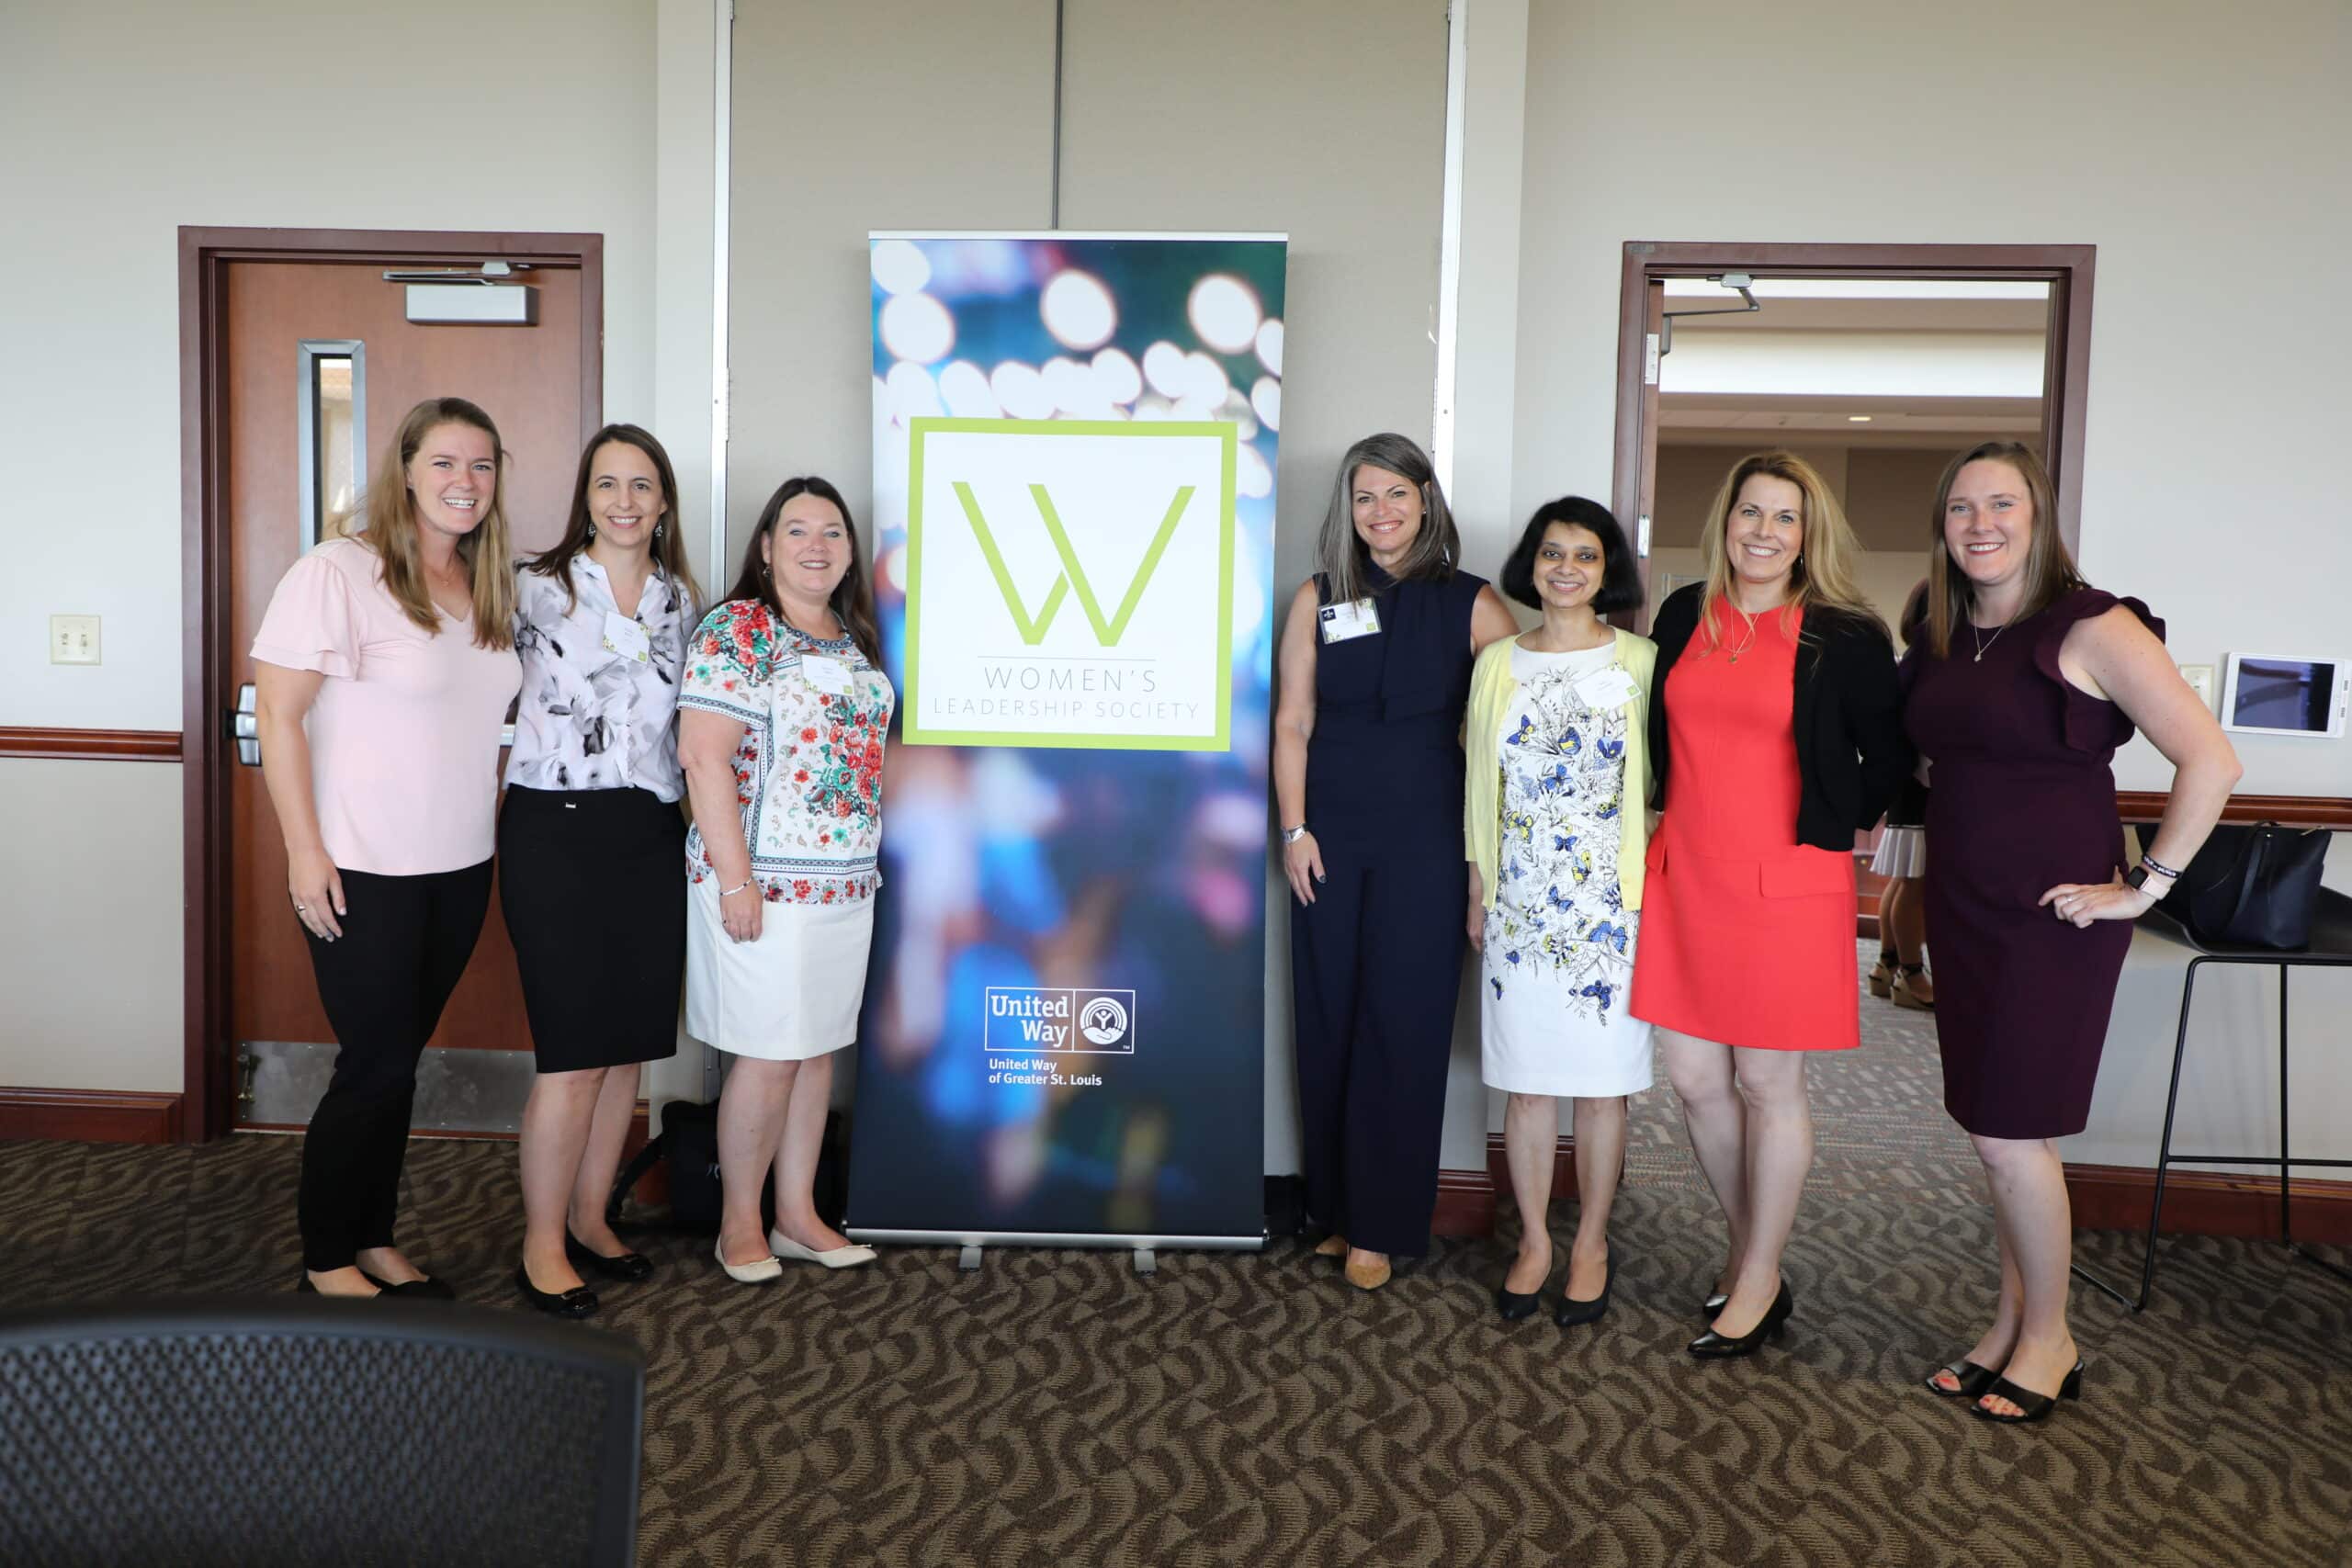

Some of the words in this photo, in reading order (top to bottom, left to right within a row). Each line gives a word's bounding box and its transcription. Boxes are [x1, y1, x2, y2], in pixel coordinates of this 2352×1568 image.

[951, 481, 1196, 647] W
[984, 667, 1156, 692] WOMEN'S
[933, 698, 1082, 717] LEADERSHIP
[1095, 701, 1199, 719] SOCIETY
[990, 995, 1069, 1018] United
[1021, 1020, 1069, 1048] Way
[989, 1058, 1029, 1070] United
[1032, 1059, 1057, 1073] Way
[989, 1072, 1001, 1084] of
[1003, 1074, 1047, 1085] Greater
[1050, 1074, 1067, 1086] St.
[1070, 1075, 1102, 1086] Louis
